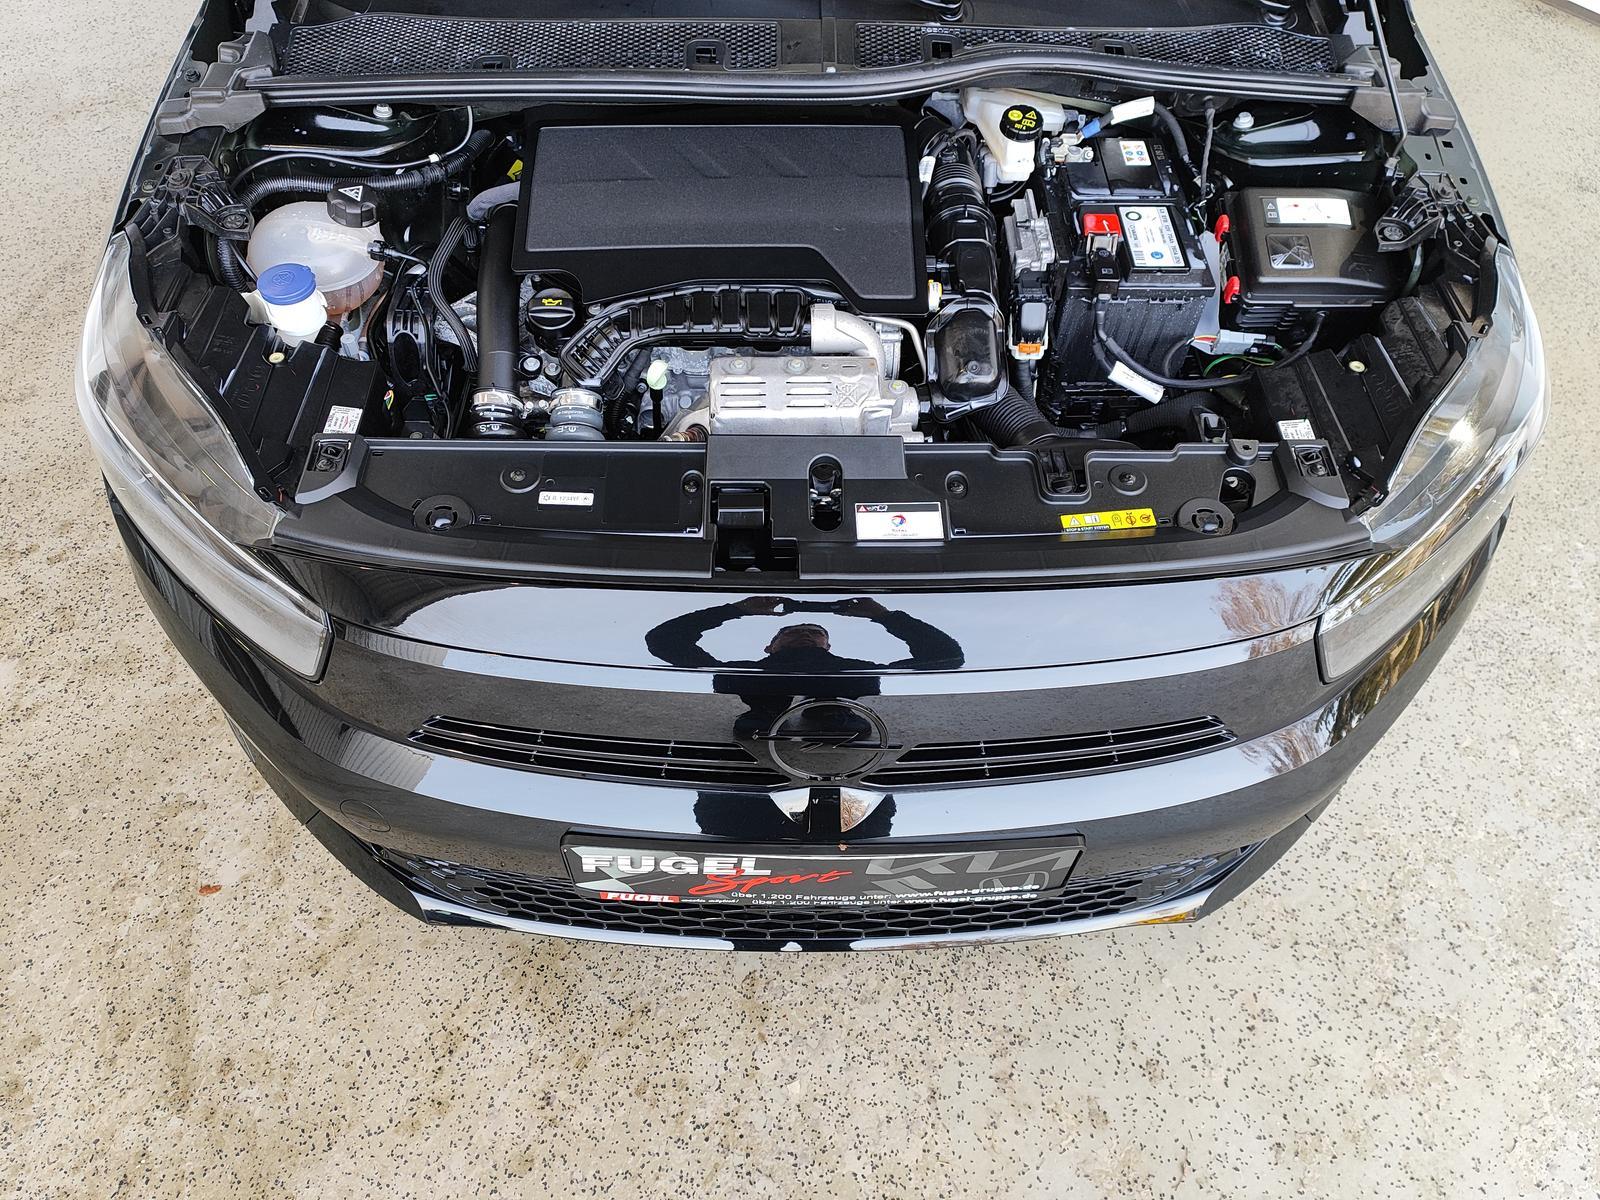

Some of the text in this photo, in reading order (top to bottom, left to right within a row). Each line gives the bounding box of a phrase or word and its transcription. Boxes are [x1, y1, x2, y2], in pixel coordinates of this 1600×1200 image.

[581, 854, 772, 876] FUGEL
[688, 867, 852, 895] Sport
[606, 892, 674, 903] FUGEL
[895, 885, 1041, 899] www.fugel-gruppe.de
